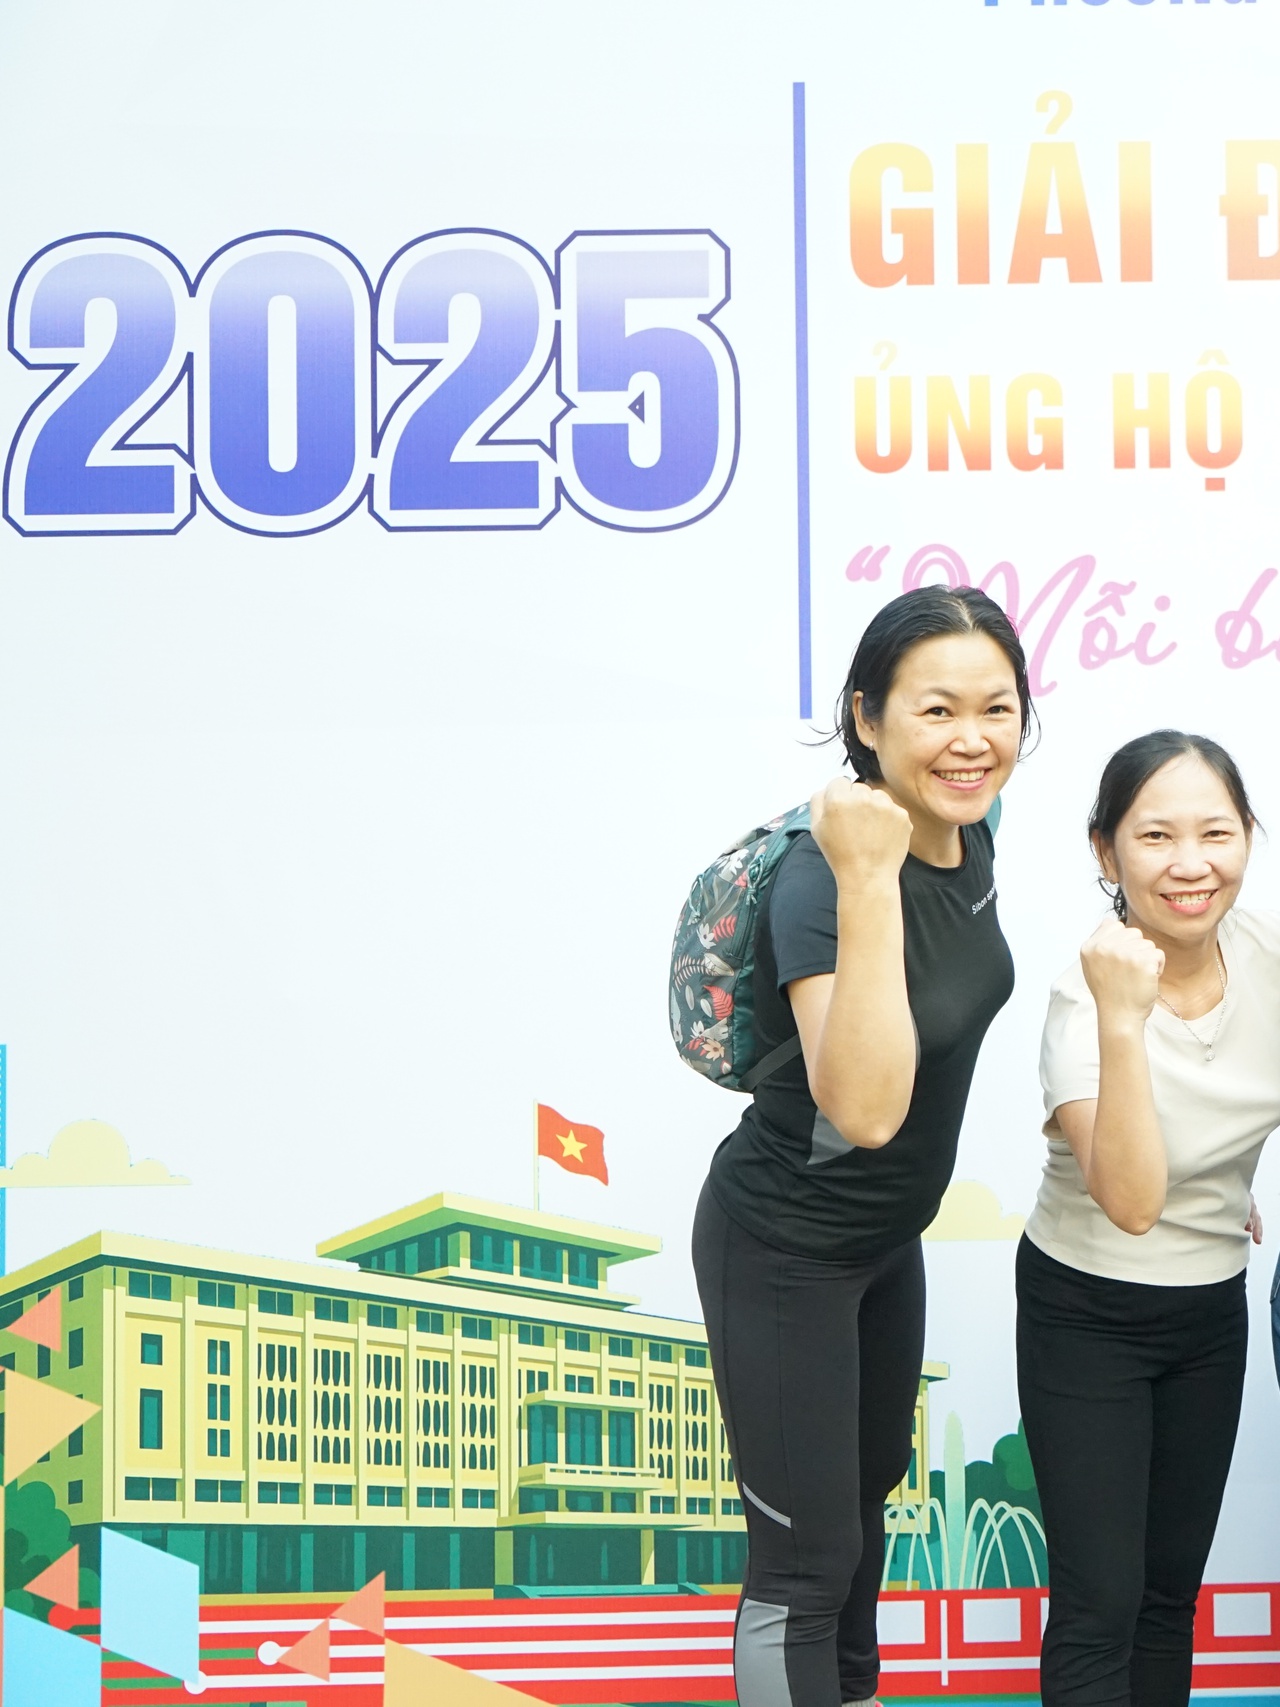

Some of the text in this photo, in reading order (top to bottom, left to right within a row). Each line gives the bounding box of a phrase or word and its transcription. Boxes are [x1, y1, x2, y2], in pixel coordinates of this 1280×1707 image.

[848, 89, 1155, 289] GIẢI
[2, 226, 741, 539] 2025
[852, 341, 1066, 476] ỦNG
[1110, 348, 1244, 493] HỘ
